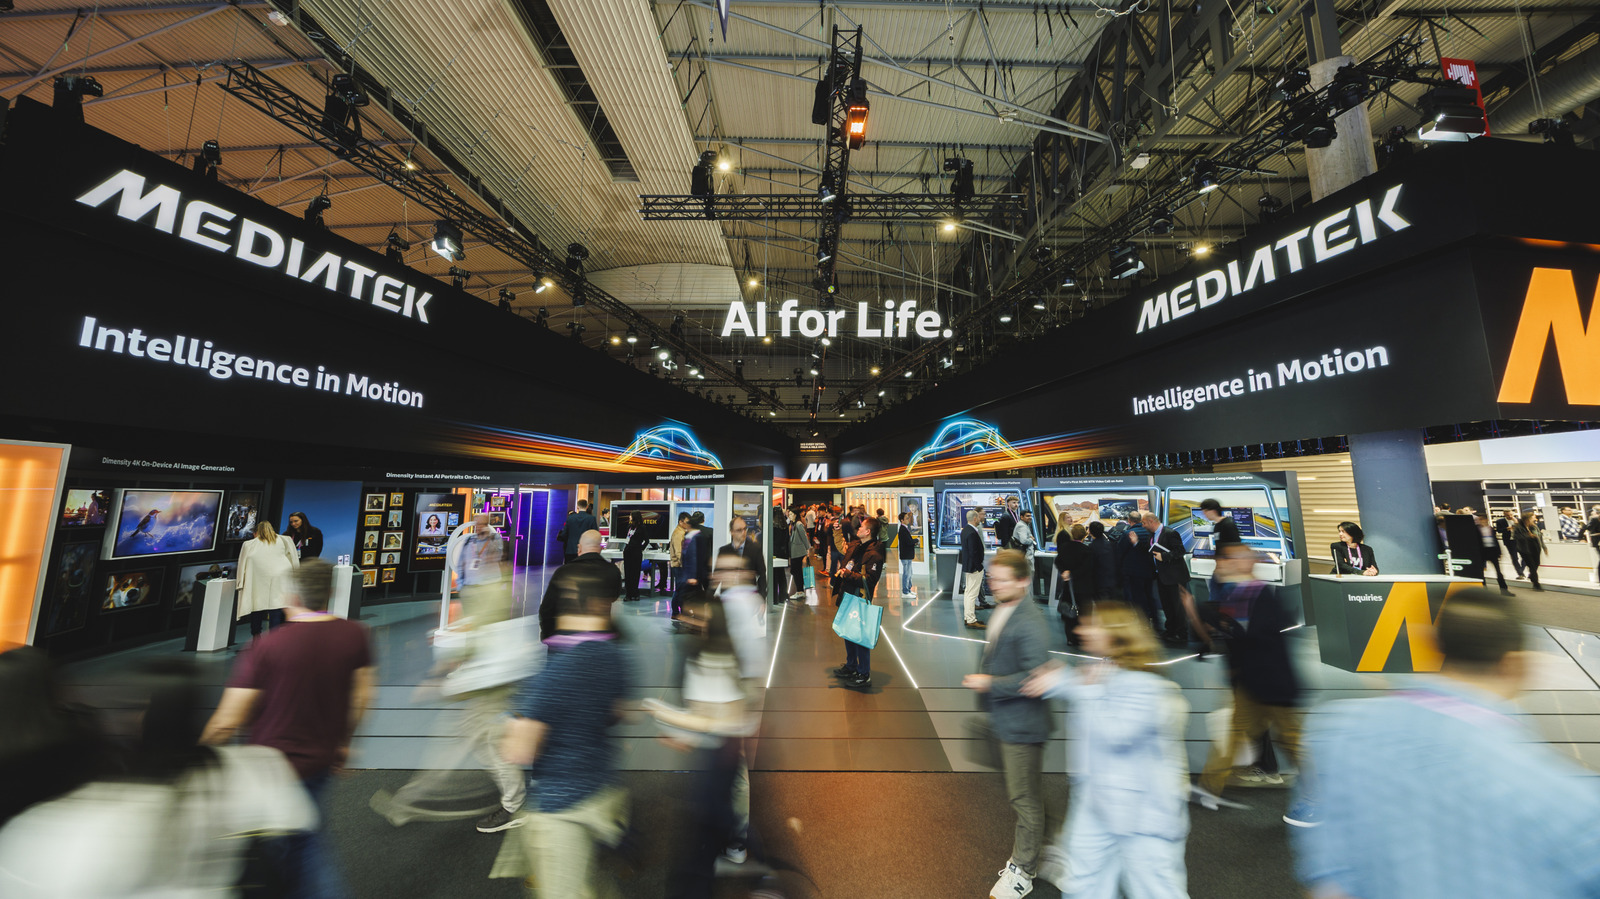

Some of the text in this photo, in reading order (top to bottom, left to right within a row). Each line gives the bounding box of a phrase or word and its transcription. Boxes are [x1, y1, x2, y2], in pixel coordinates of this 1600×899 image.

[75, 169, 433, 324] MEDIATEK
[1136, 183, 1411, 334] MEDIATEK
[721, 299, 953, 338] AI for Life.
[79, 316, 424, 408] Intelligence in Motion
[1132, 345, 1390, 416] Intelligence in Motion
[102, 456, 131, 467] Dimensity
[141, 460, 172, 469] On-Device
[180, 463, 200, 471] Image
[200, 464, 235, 472] Generation
[800, 463, 828, 482] M
[1348, 594, 1383, 603] Inquiries
